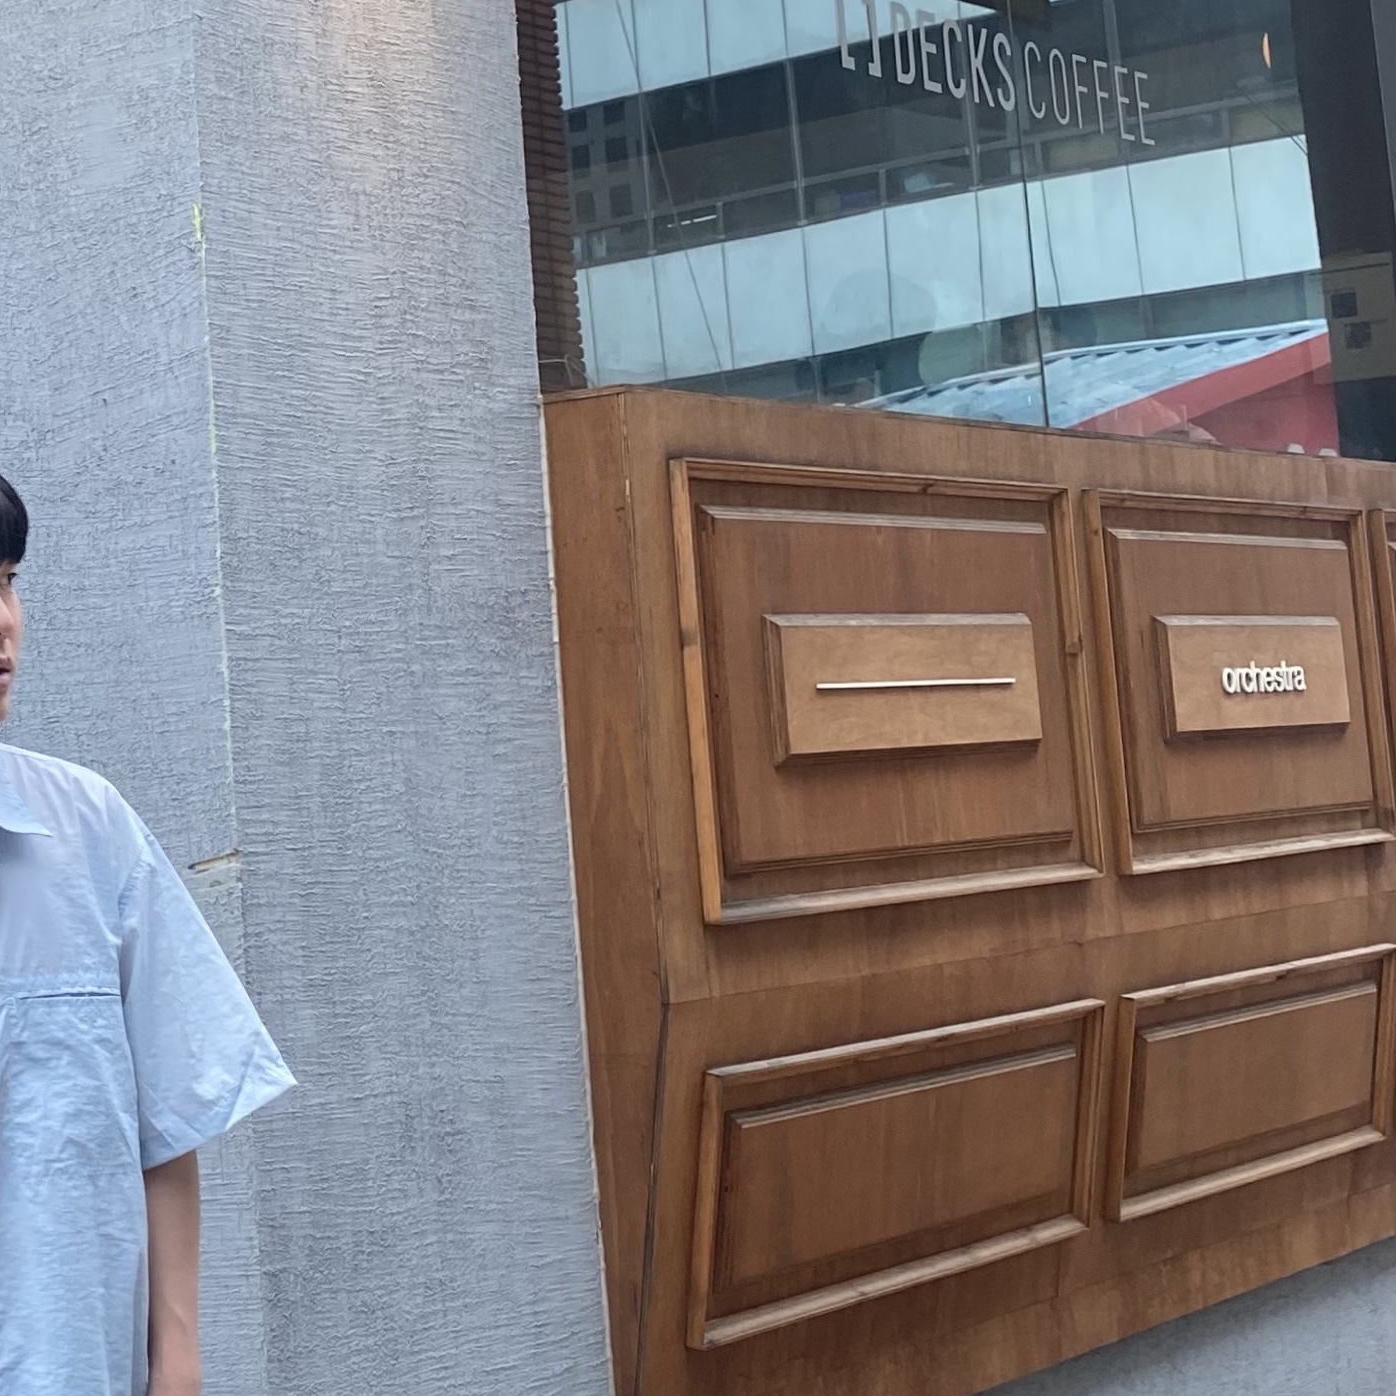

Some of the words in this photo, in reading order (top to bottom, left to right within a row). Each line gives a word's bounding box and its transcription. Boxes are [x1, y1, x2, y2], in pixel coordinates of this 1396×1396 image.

[890, 1, 1015, 112] DECKS
[1024, 41, 1155, 145] COFFEE
[1222, 660, 1306, 693] orchestra
